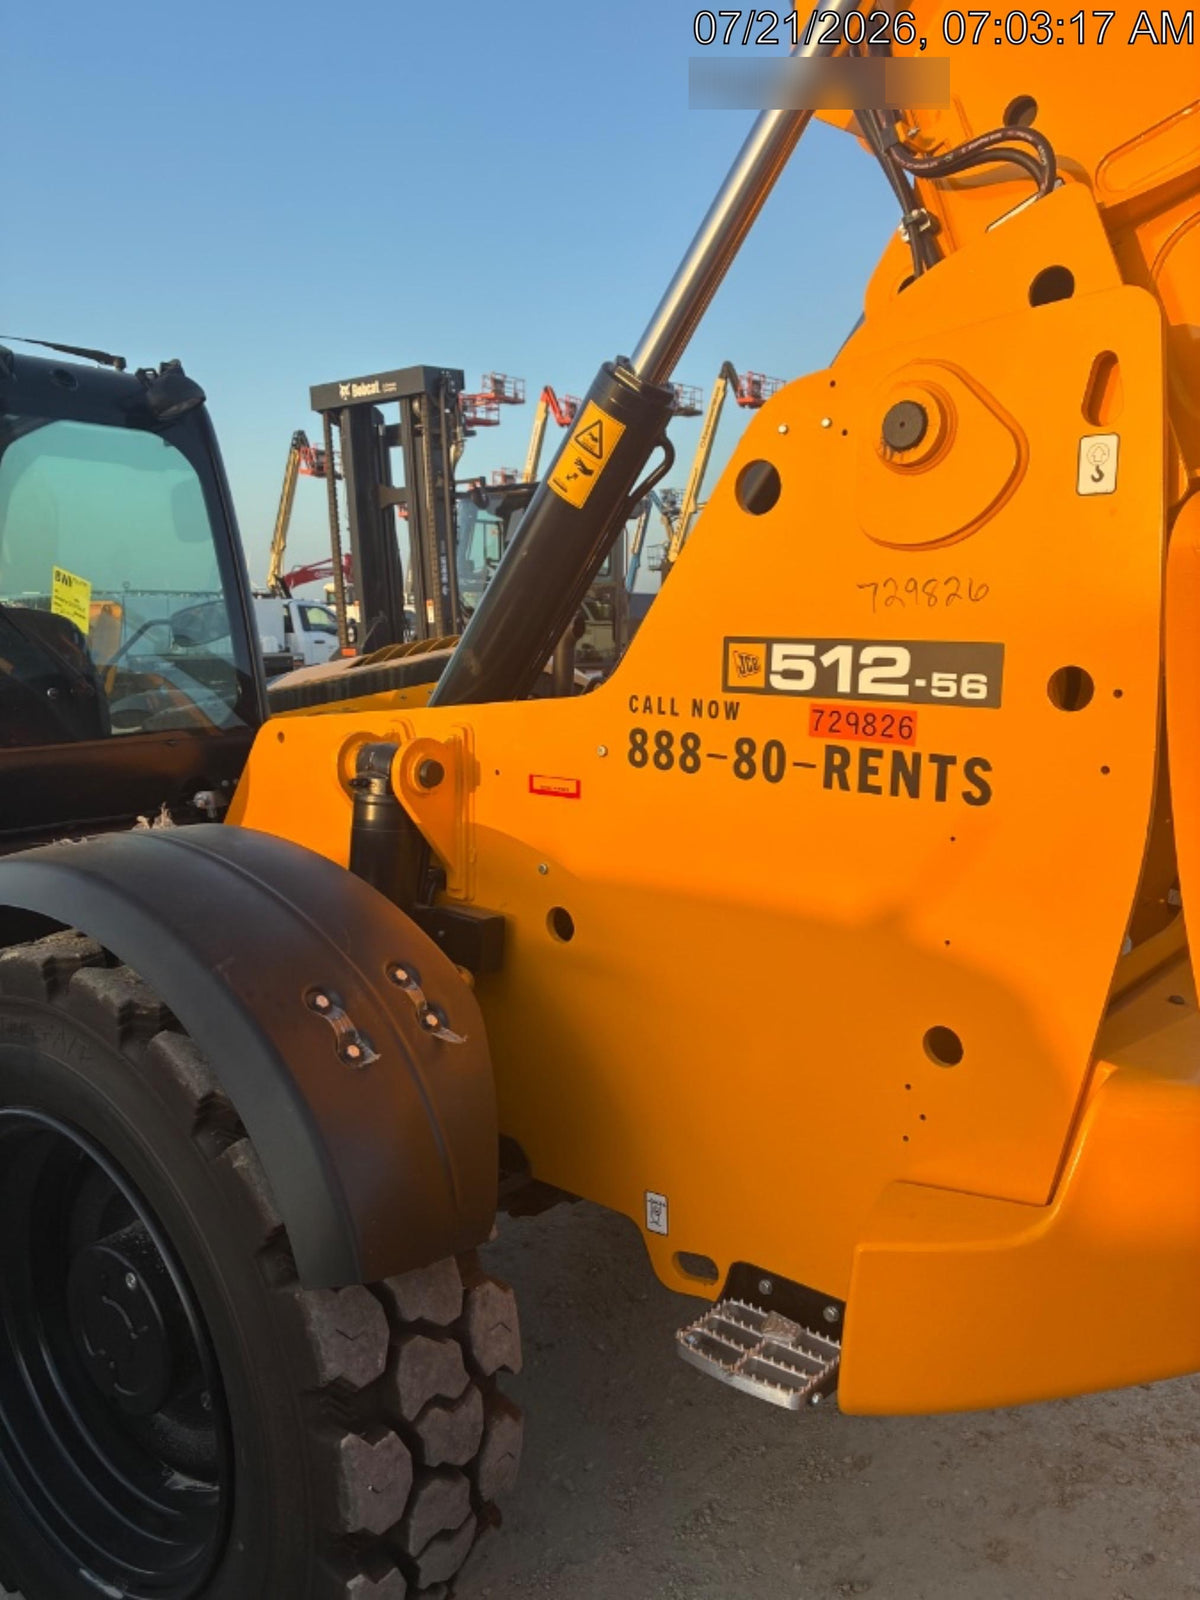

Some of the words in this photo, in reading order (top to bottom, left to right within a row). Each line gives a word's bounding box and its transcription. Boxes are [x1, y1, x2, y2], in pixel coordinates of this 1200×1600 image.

[352, 379, 381, 398] Bobcat
[857, 577, 990, 613] 729826
[732, 649, 762, 678] JCB
[769, 644, 988, 698] 512-56
[628, 694, 680, 718] CALL
[691, 698, 741, 721] NOW
[811, 708, 914, 740] 729826
[627, 727, 994, 807] 888-80-RENTS
